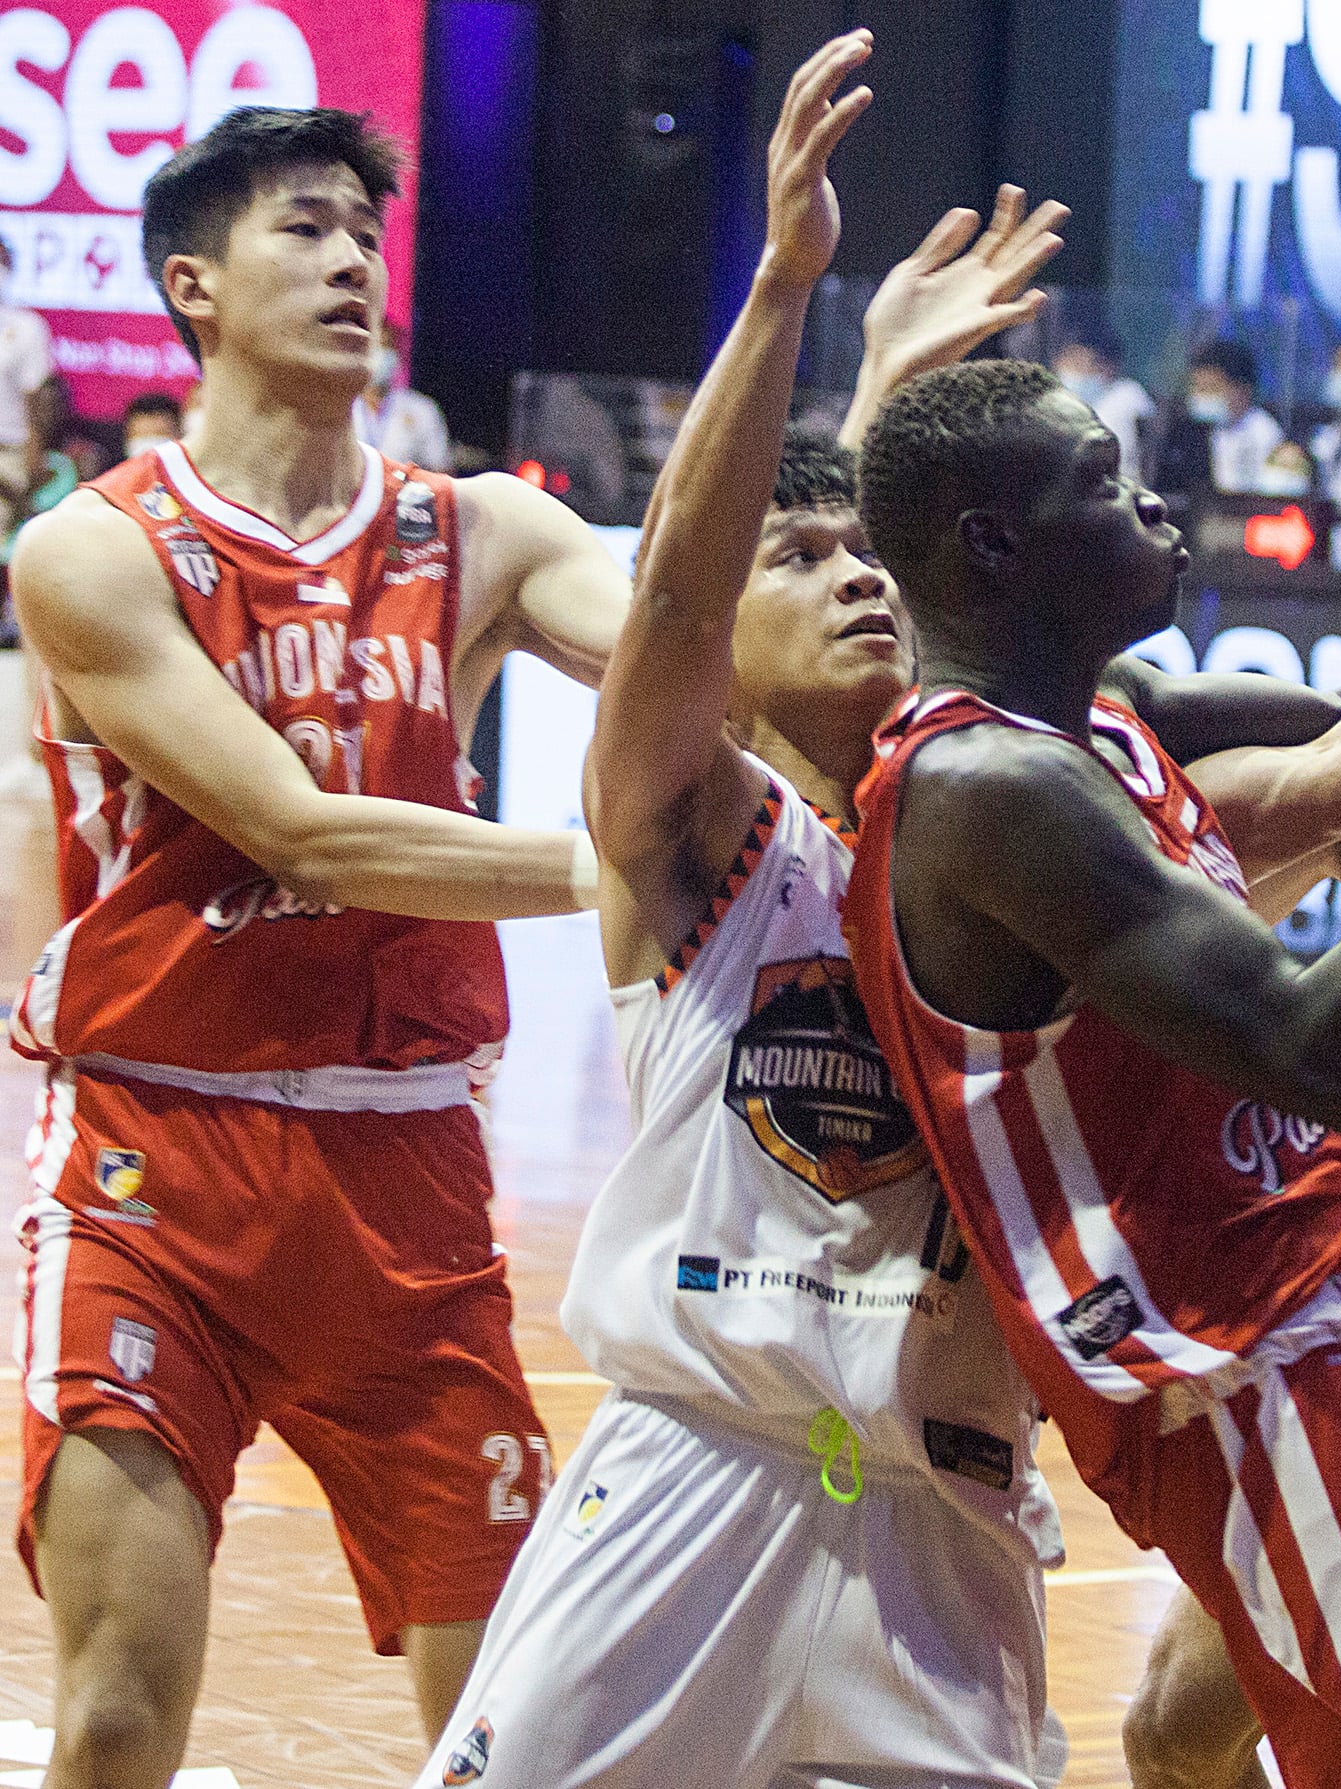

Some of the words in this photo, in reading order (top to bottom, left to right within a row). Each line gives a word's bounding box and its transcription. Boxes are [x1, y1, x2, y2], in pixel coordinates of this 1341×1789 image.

[735, 1046, 882, 1098] MOUNTAIN
[724, 1268, 753, 1289] PT
[760, 1267, 849, 1306] FREEPORT
[480, 1431, 552, 1523] 21
